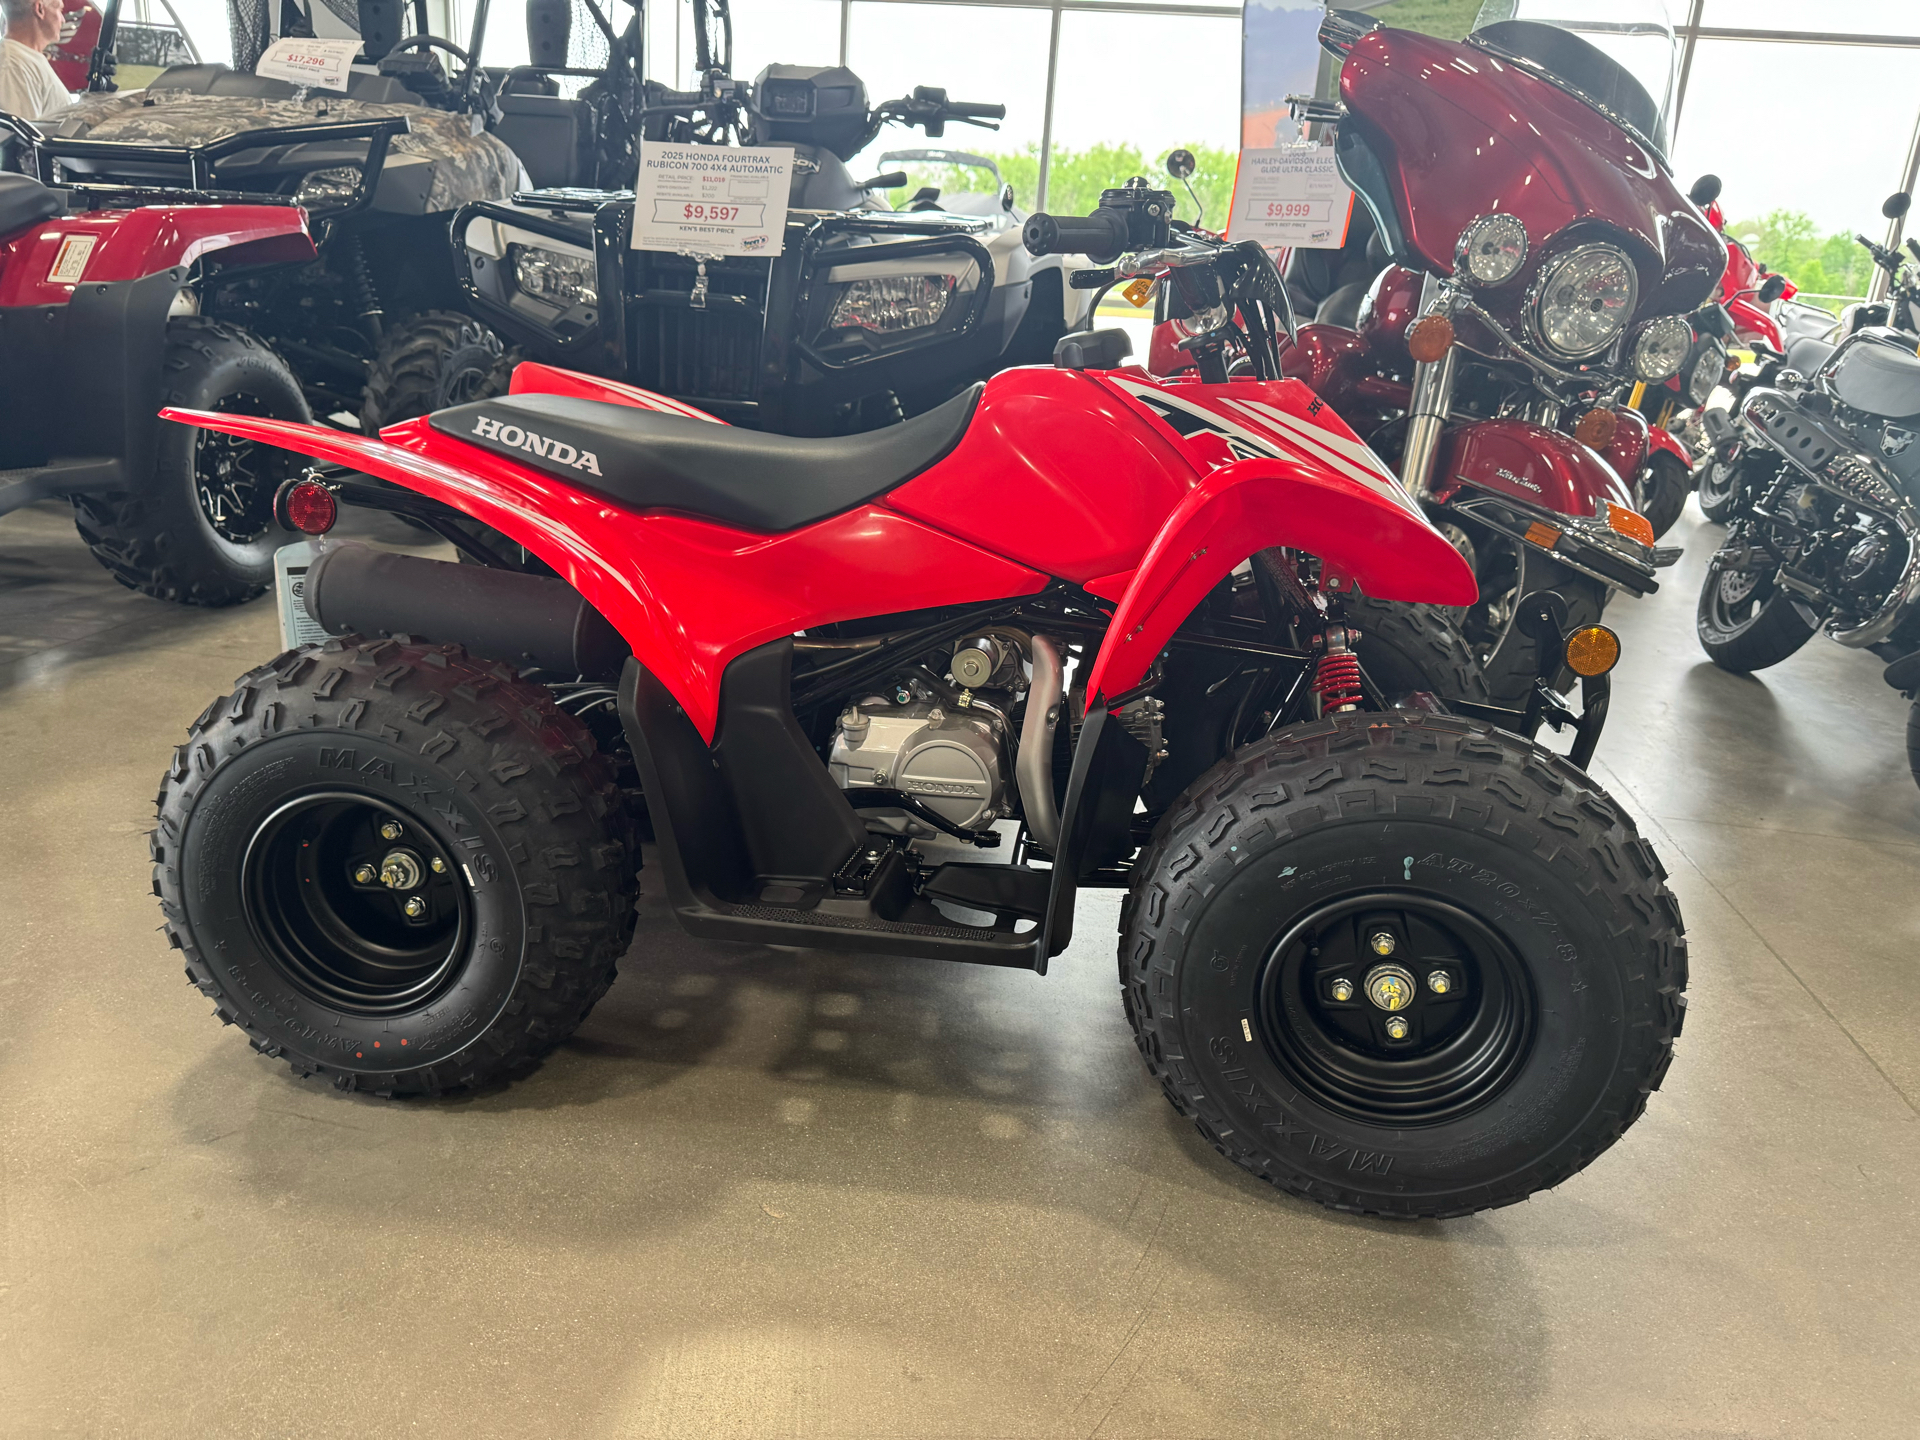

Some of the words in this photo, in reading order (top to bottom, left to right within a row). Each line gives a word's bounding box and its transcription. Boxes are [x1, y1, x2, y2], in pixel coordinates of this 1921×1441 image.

[287, 53, 325, 66] $17,296
[661, 151, 684, 160] 2025
[686, 152, 720, 162] HONDA
[722, 154, 771, 164] FOURTRAX
[1251, 157, 1315, 165] HARLEY-DAVIDSON
[1316, 157, 1333, 165] ELEC
[646, 160, 690, 170] RUBICON
[691, 161, 708, 171] 700
[710, 163, 728, 172] 4X4
[729, 164, 784, 174] AUTOMATIC
[1304, 165, 1334, 173] CLASSIC
[683, 203, 739, 222] $9,597
[1266, 202, 1310, 218] $9,999
[471, 415, 603, 476] HONDA
[907, 780, 980, 796] HONDA
[318, 745, 500, 883] MAXXIS
[1209, 1035, 1397, 1176] MAXXIS
